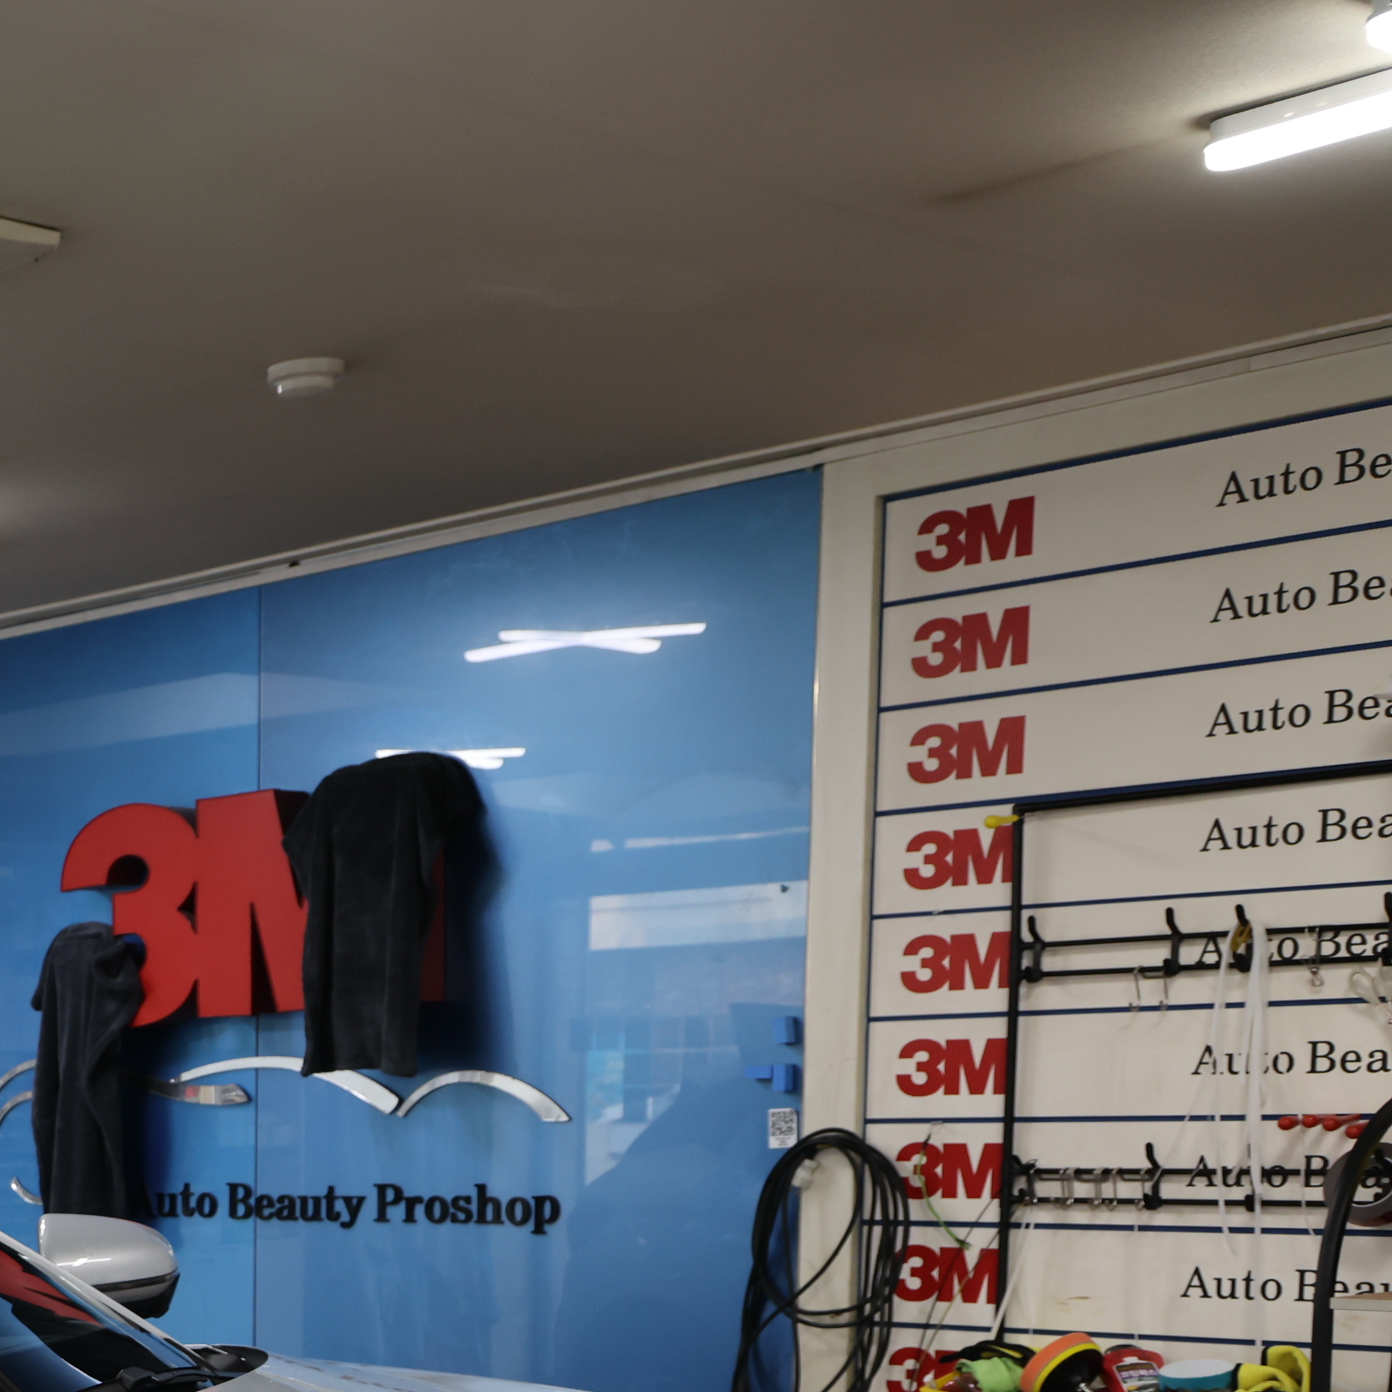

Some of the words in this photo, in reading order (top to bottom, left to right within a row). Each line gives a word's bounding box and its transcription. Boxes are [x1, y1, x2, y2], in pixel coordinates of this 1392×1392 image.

[1215, 463, 1323, 508] Auto
[915, 495, 1035, 573] 3M
[1210, 582, 1316, 624] Auto
[1327, 569, 1392, 606] Be
[911, 605, 1030, 679] 3M
[1205, 698, 1311, 738] Auto
[907, 715, 1026, 784] 3M
[903, 825, 1013, 890] 3M
[1199, 815, 1305, 853] Auto
[900, 931, 1011, 993] 3M
[1195, 934, 1300, 965] Ao
[896, 1037, 1007, 1097] 3M
[1191, 1045, 1295, 1075] Auo
[1306, 1041, 1392, 1074] Bea
[896, 1143, 1004, 1199] 3M
[226, 1182, 367, 1229] Beauty
[373, 1183, 561, 1235] Proshop
[892, 1244, 999, 1304] 3M
[1180, 1266, 1283, 1301] Auto
